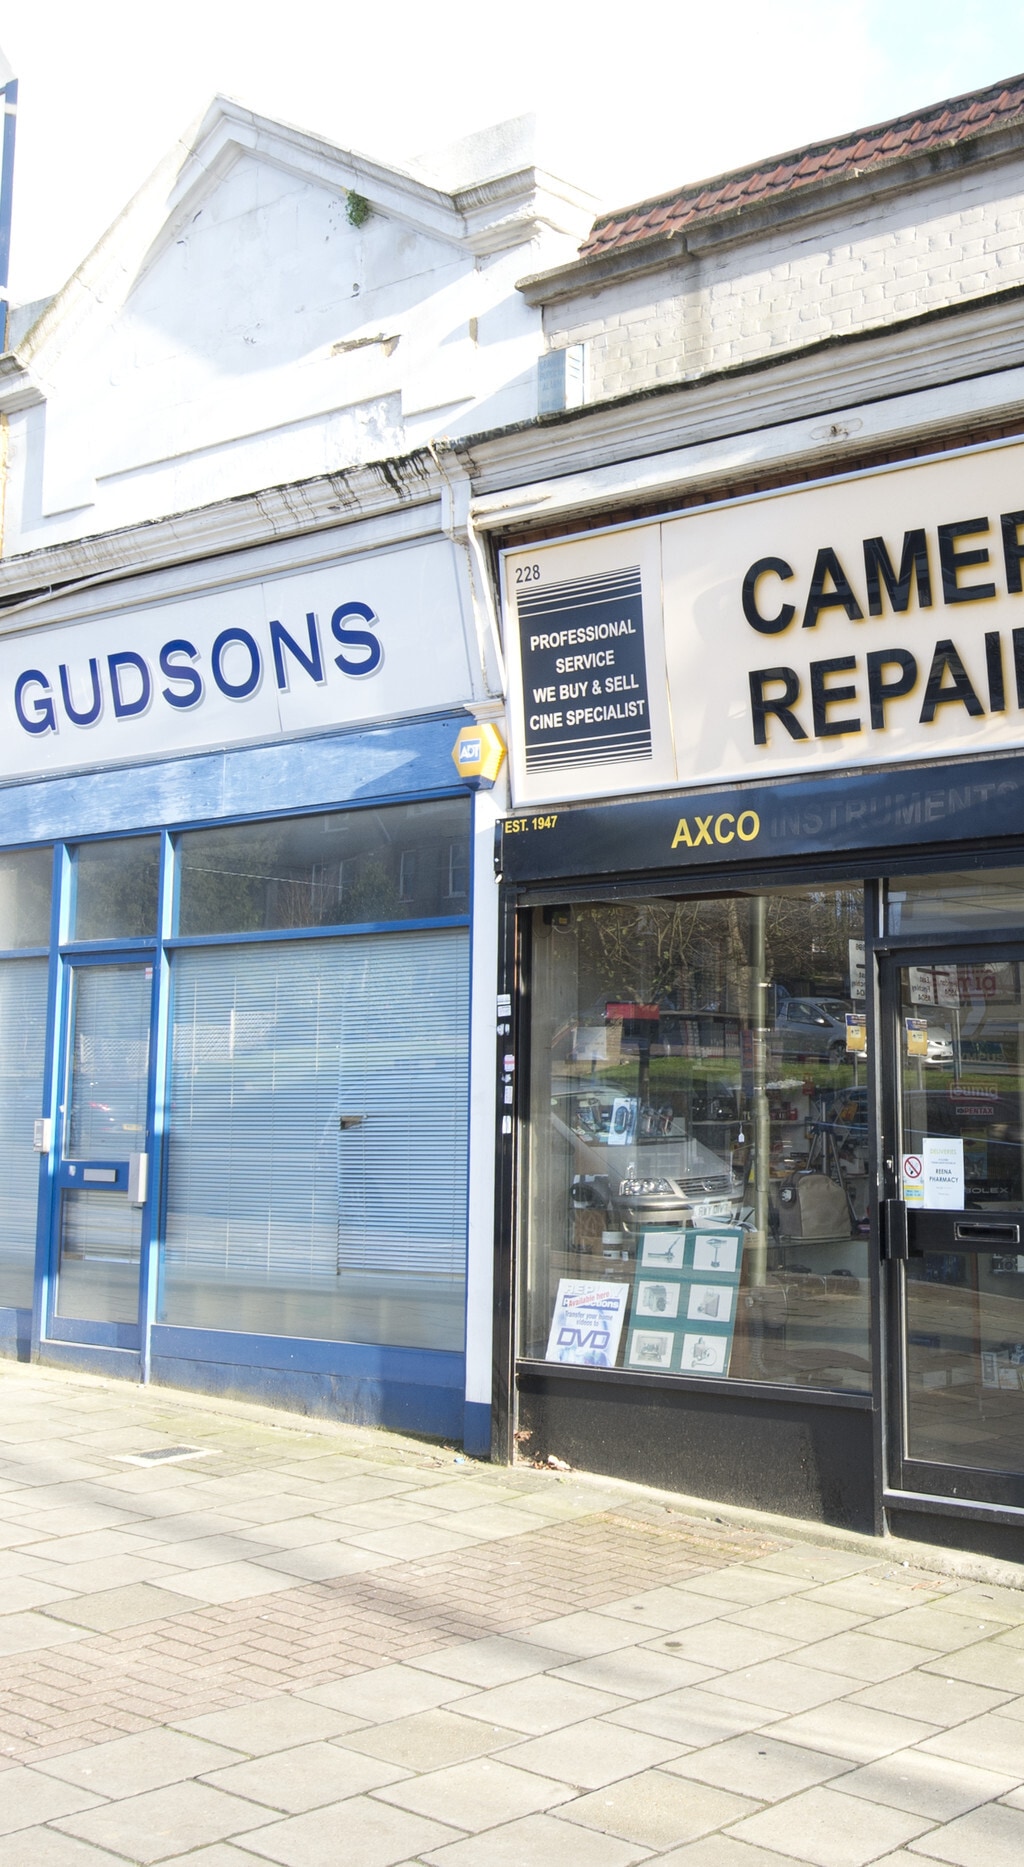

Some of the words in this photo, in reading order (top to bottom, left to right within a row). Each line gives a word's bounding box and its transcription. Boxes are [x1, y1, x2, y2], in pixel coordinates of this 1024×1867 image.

[515, 564, 541, 584] 228
[530, 619, 636, 651] PROFESSIONAL
[14, 601, 384, 735] GUDSONS
[555, 649, 615, 674] SERVICE
[533, 686, 557, 704] WE
[559, 681, 588, 700] BUY
[592, 679, 602, 696] &
[605, 673, 640, 693] SELL
[529, 712, 563, 731] CINE
[566, 699, 645, 727] SPECIALIST
[459, 744, 480, 759] ADT
[504, 818, 529, 834] EST.
[531, 815, 558, 831] 1947
[670, 810, 761, 849] AXCO
[964, 1106, 994, 1115] PENTAX
[929, 1176, 959, 1184] PHARMACY
[568, 1294, 595, 1307] Available
[596, 1291, 610, 1300] here
[556, 1327, 611, 1350] DVD
